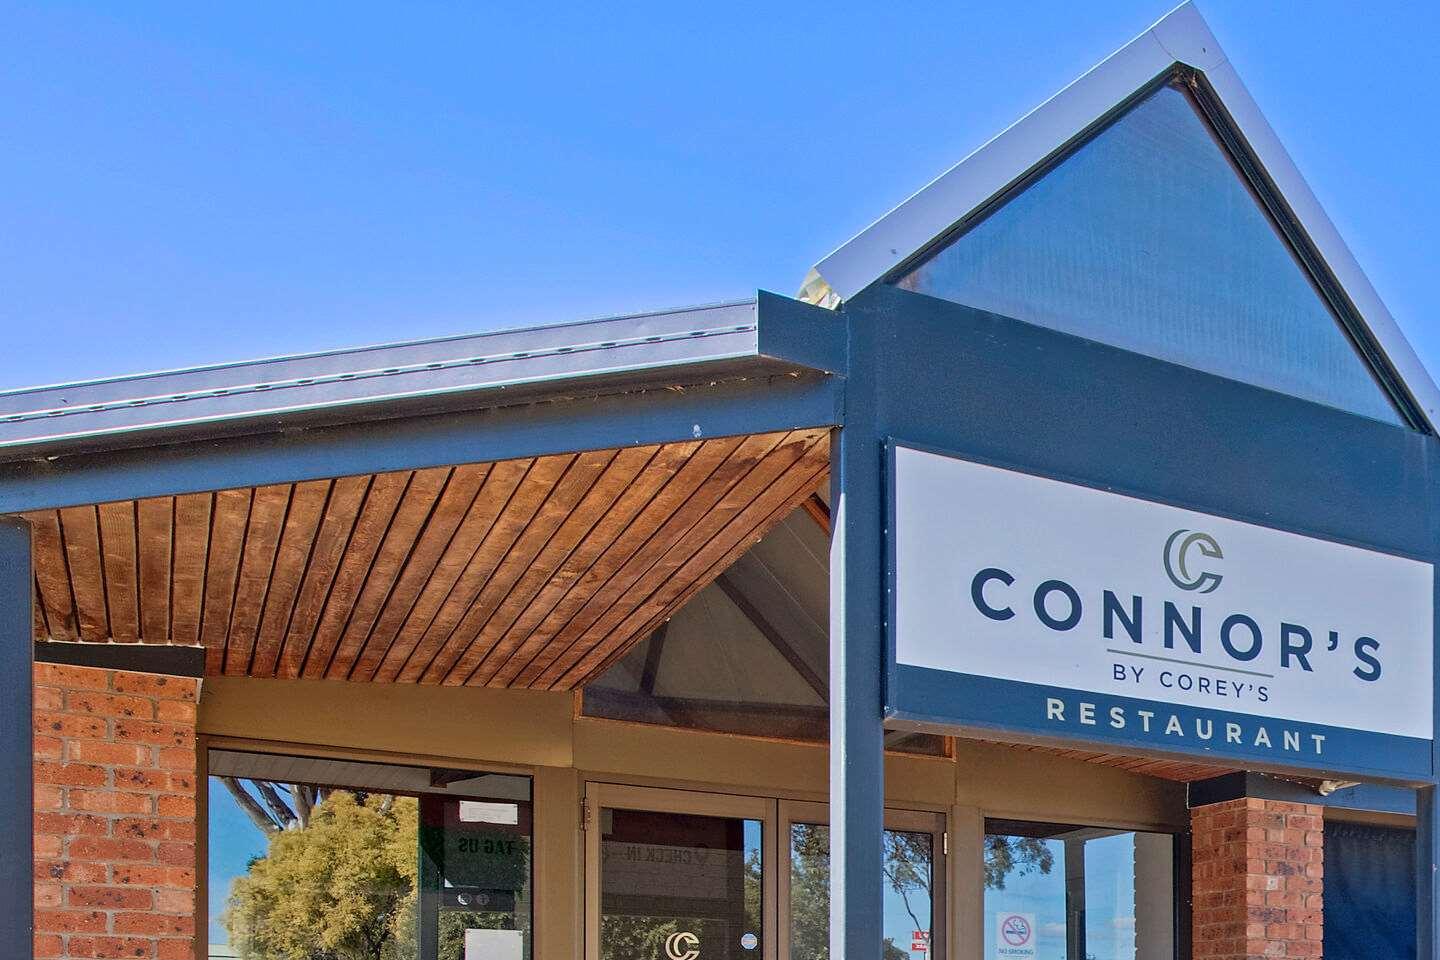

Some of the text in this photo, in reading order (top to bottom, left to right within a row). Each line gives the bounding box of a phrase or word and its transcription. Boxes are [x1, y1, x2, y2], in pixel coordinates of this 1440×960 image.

[970, 567, 1382, 683] CONNOR'S
[1113, 663, 1270, 702] BY COREY'S
[1046, 697, 1326, 754] RESTAURANT
